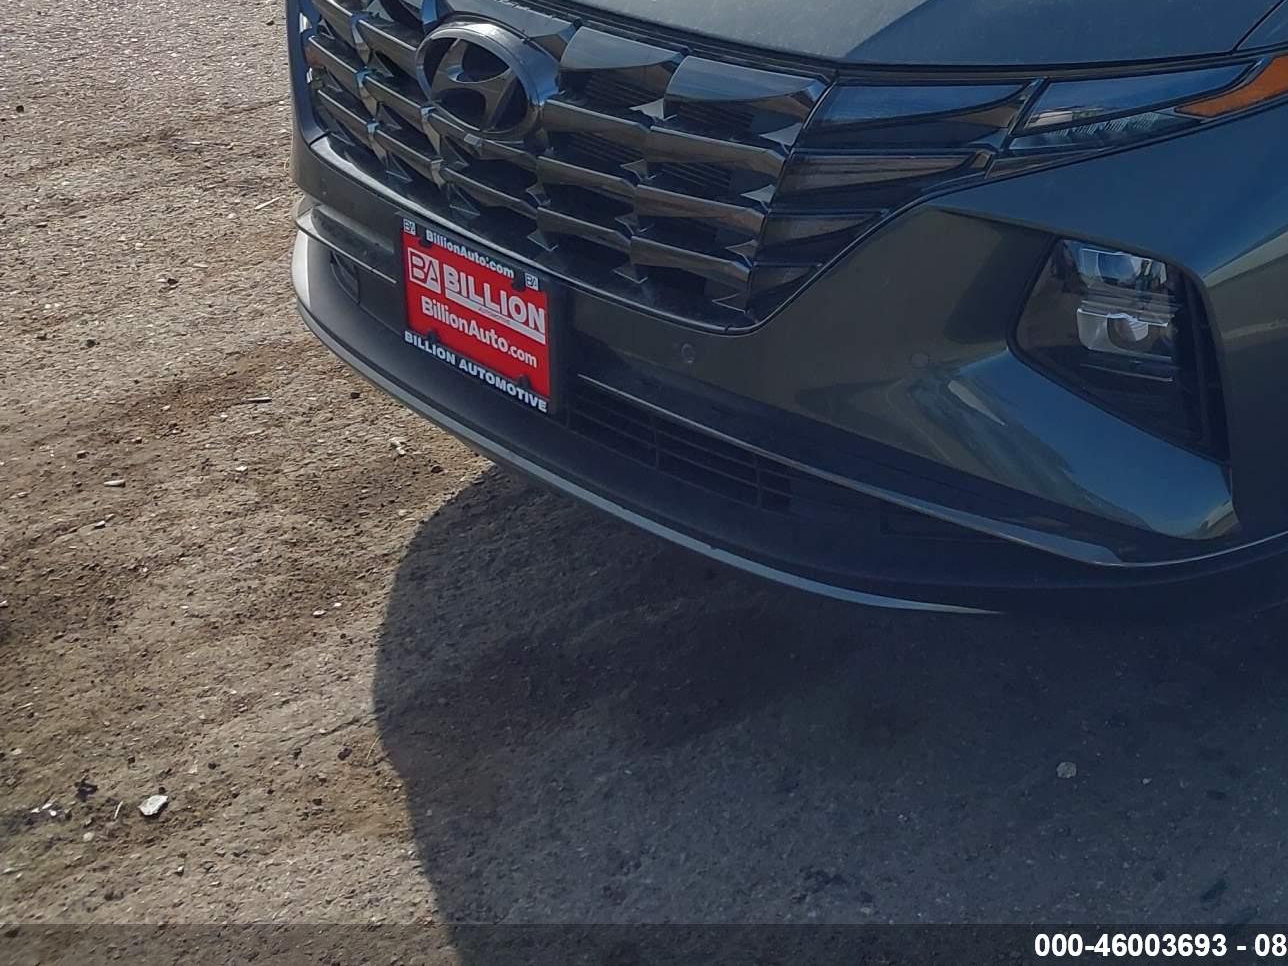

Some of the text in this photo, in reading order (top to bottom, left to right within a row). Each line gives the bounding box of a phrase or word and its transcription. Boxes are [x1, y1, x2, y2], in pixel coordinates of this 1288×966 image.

[425, 229, 515, 278] BillionAuto.com
[421, 296, 537, 368] BillionAuto.com
[443, 264, 546, 333] BILLION
[404, 330, 548, 413] BILLION AUTOMOTIVE
